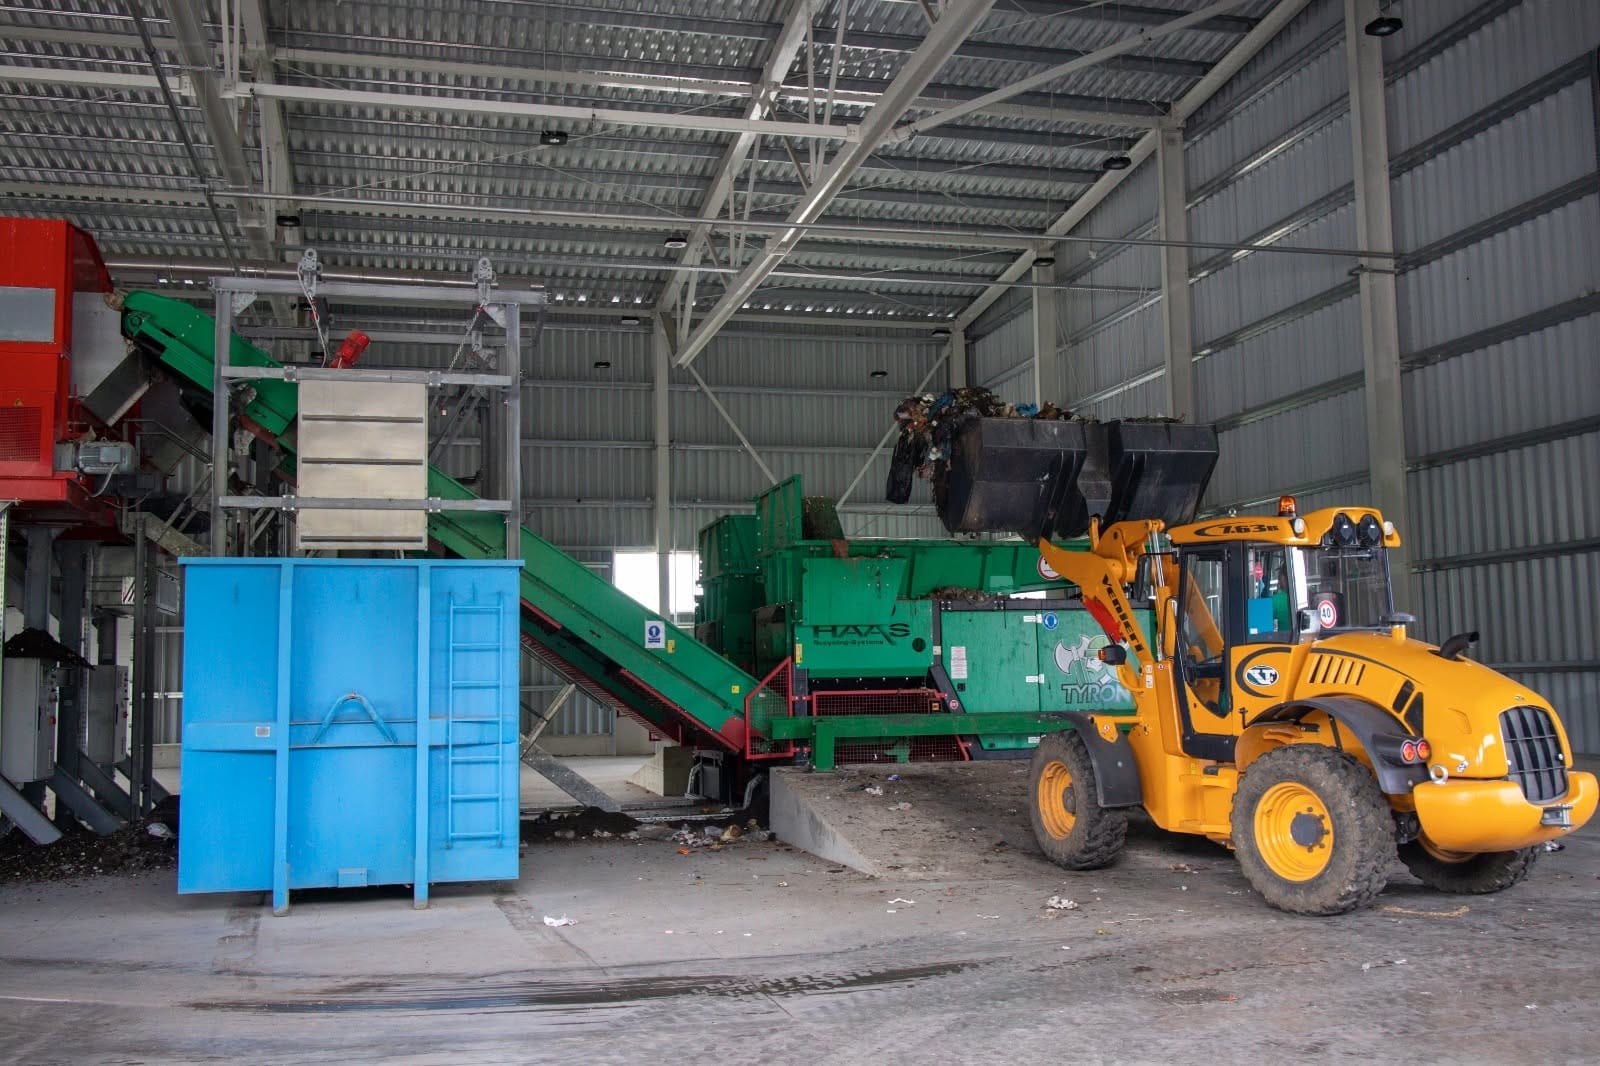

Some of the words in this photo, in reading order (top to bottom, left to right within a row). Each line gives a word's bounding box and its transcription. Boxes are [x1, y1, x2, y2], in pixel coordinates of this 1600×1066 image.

[1321, 607, 1332, 618] 40
[812, 623, 910, 645] HAAS
[1061, 683, 1132, 704] TYRON
